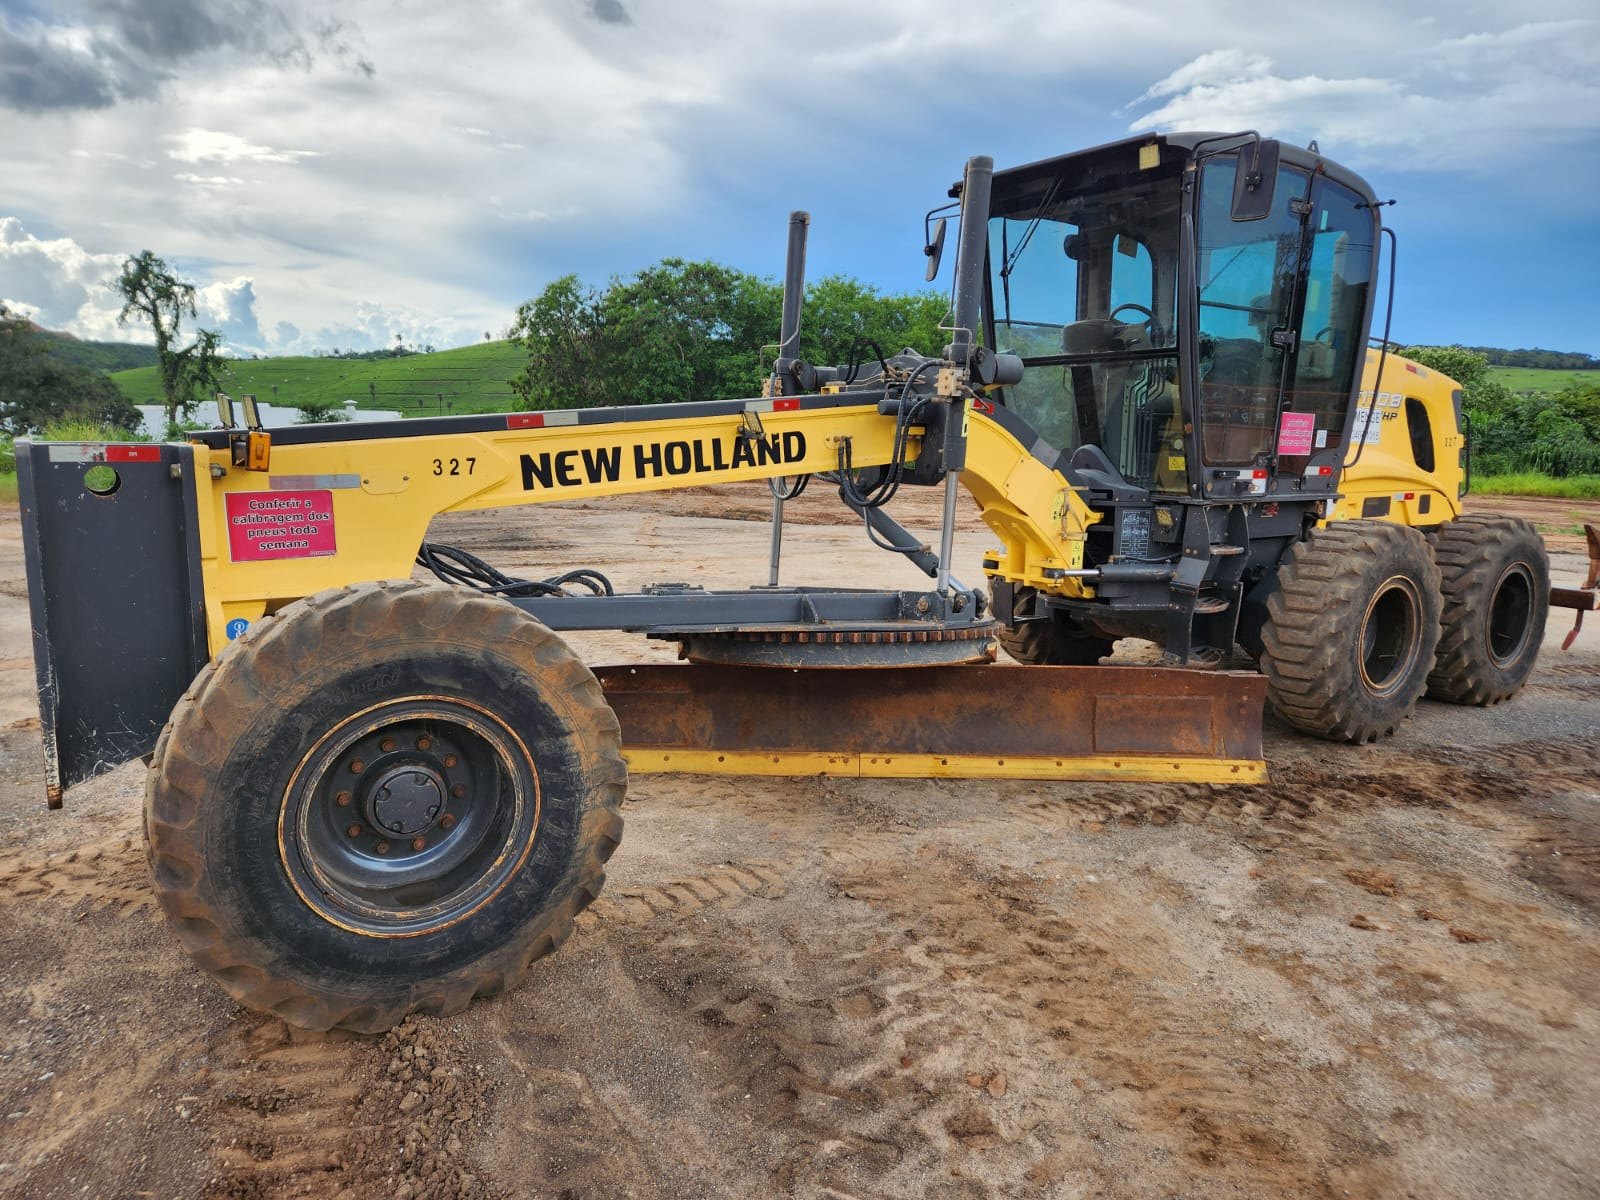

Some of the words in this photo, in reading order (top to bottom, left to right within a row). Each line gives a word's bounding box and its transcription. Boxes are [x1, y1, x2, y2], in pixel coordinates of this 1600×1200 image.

[432, 457, 476, 476] 327
[519, 446, 622, 491] NEW
[633, 430, 807, 479] HOLLAND
[249, 498, 302, 510] Conferir
[304, 500, 312, 509] a
[232, 513, 304, 526] calibragem
[307, 511, 329, 522] dos
[247, 528, 286, 539] pneus
[290, 525, 318, 535] toda
[259, 540, 309, 550] semana
